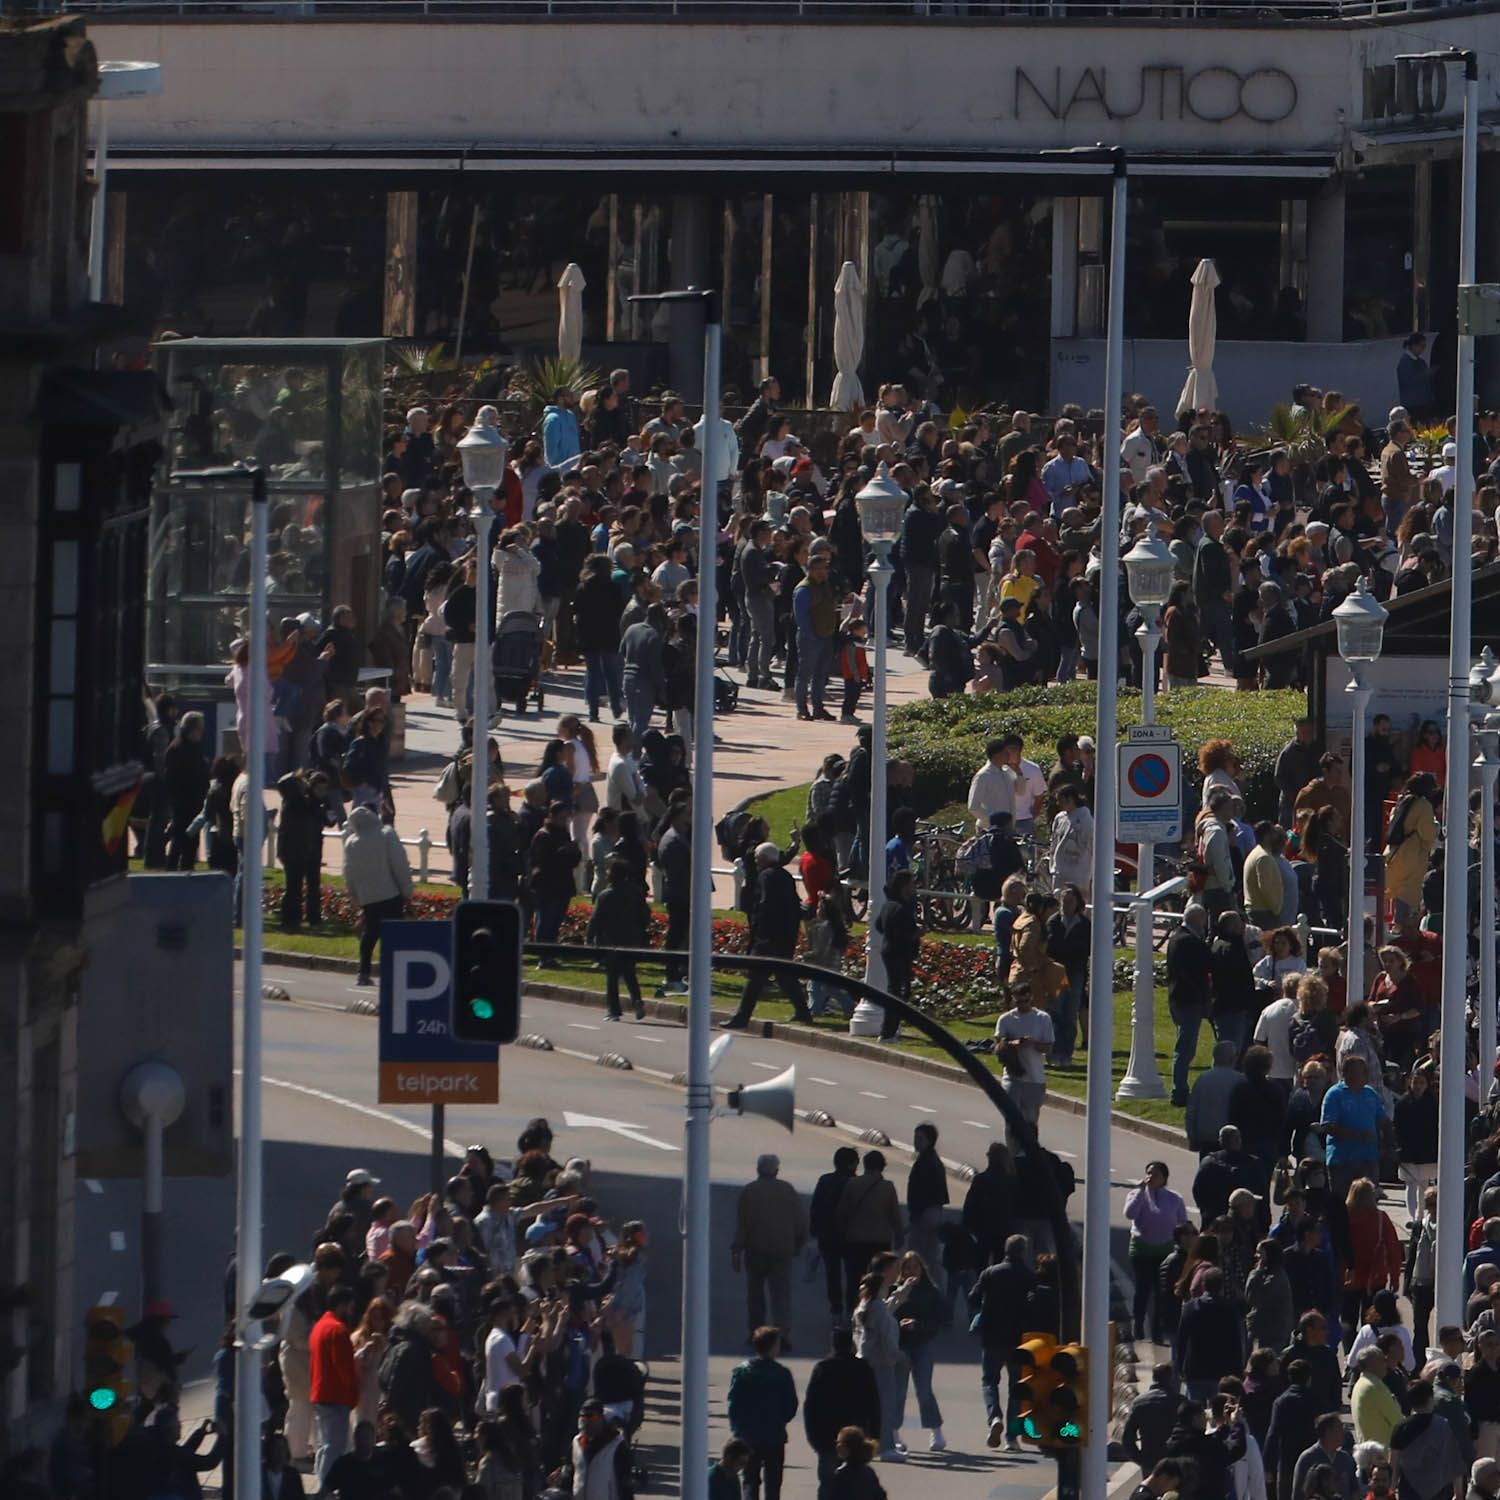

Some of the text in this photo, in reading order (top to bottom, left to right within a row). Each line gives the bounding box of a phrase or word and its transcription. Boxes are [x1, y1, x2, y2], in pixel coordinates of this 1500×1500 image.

[1014, 65, 1299, 123] NAUTICO
[391, 949, 452, 1035] P
[416, 1019, 448, 1035] 24h
[396, 1072, 480, 1096] telpark
